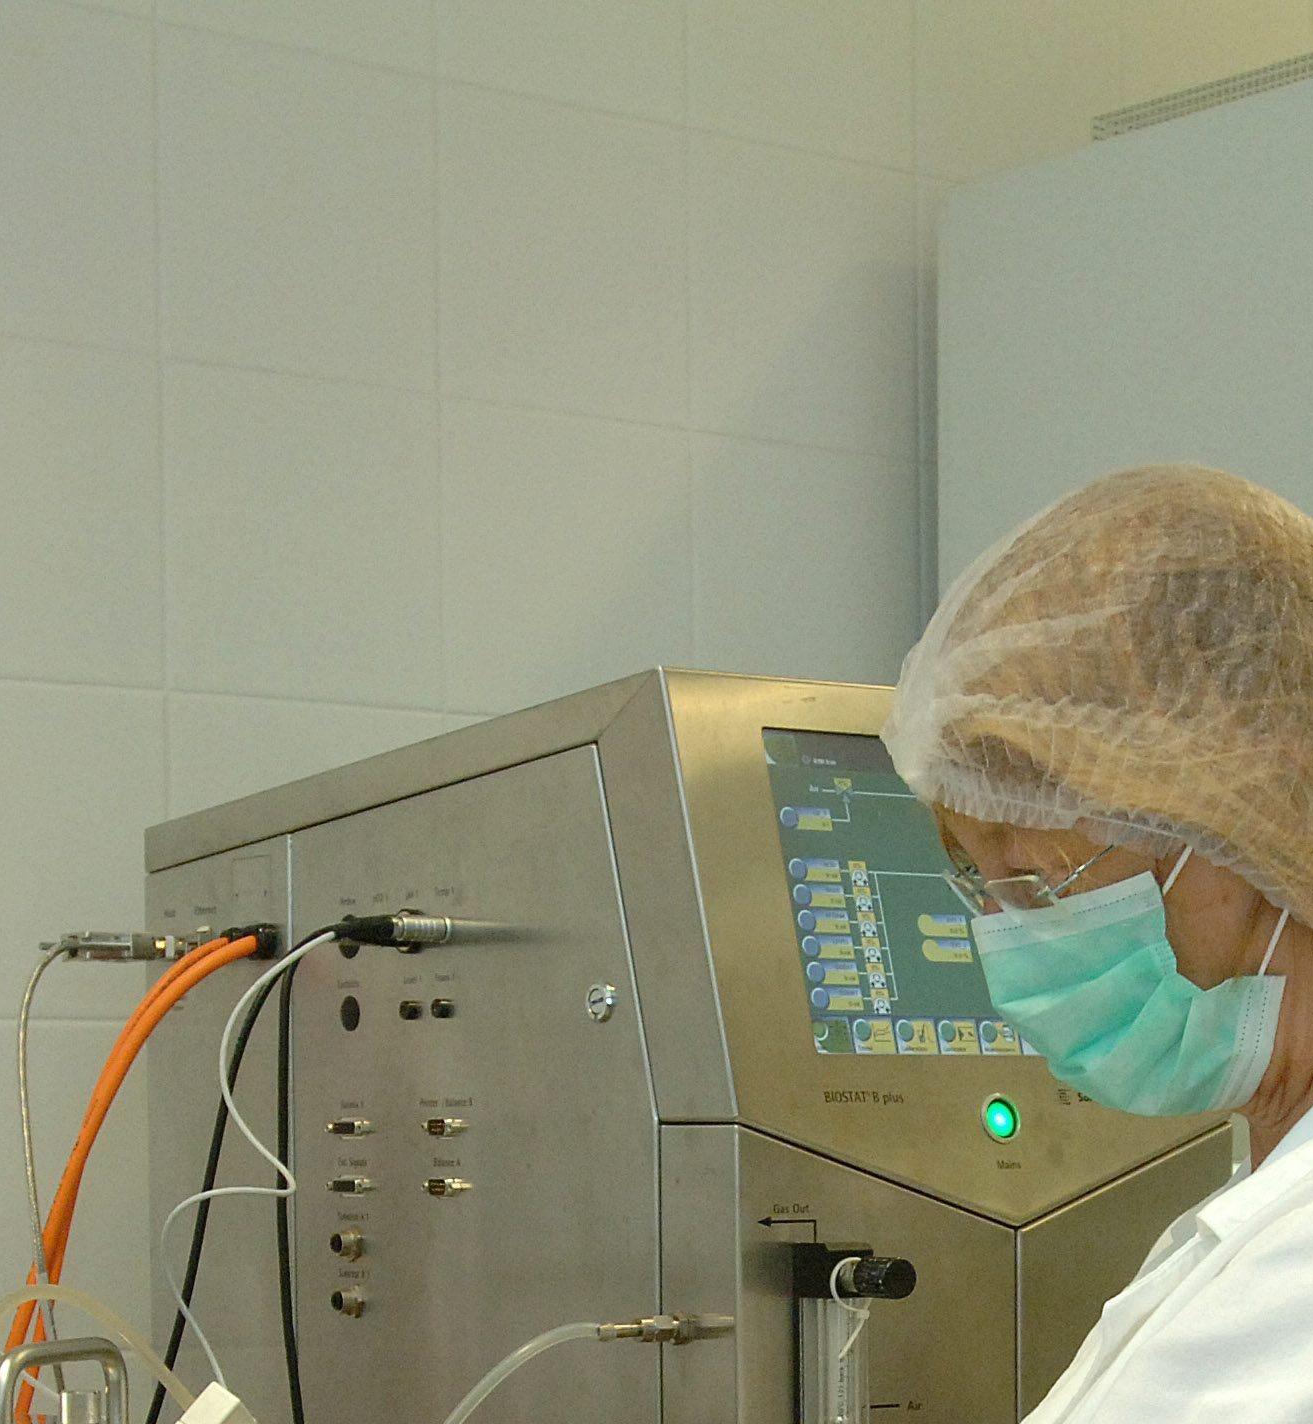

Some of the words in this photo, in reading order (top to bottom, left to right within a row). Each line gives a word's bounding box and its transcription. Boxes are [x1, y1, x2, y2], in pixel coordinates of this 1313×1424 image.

[872, 1091, 880, 1103] B
[882, 1091, 904, 1105] plus
[996, 1160, 1021, 1170] Mains
[773, 1203, 790, 1214] Gas
[792, 1203, 809, 1214] Out
